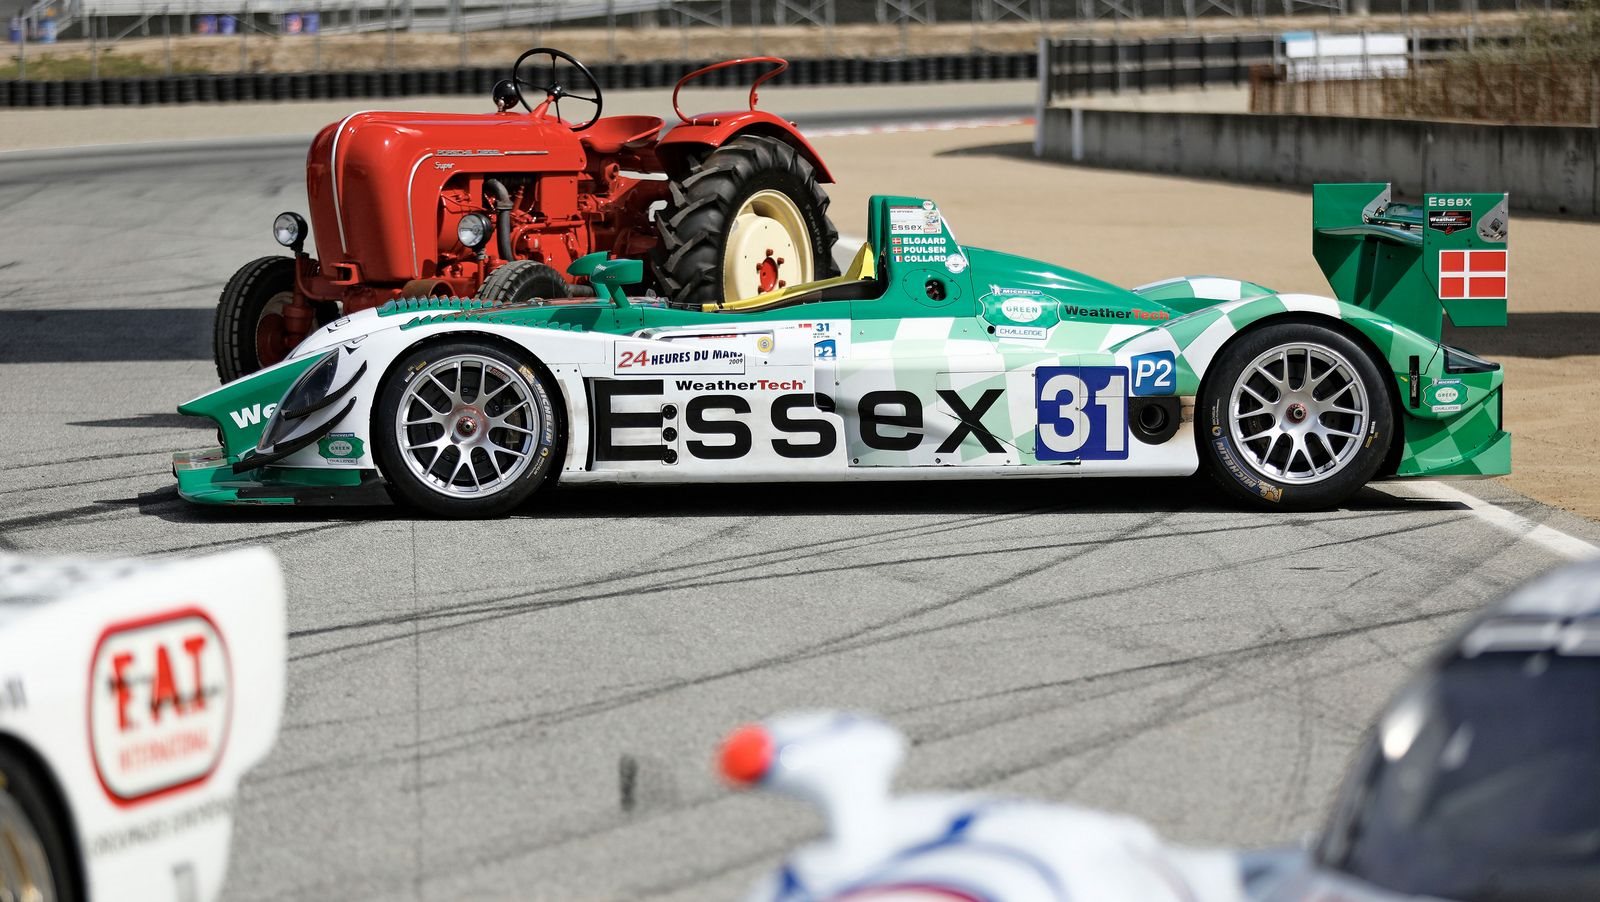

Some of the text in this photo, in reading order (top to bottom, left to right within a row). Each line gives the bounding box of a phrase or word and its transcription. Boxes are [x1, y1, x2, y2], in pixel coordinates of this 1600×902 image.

[1428, 196, 1472, 207] Essex
[891, 223, 923, 231] Essex
[903, 237, 947, 245] ELGAARD
[903, 246, 947, 254] POULSEN
[904, 255, 947, 263] COLLARD
[1006, 305, 1039, 314] GREEN
[1064, 304, 1171, 321] WeatherTech
[816, 322, 830, 332] 31
[999, 328, 1043, 337] CHALLENGE
[814, 346, 834, 358] P2
[617, 349, 650, 369] 24
[651, 351, 691, 366] HEURES
[693, 350, 709, 362] DU
[1134, 358, 1173, 388] P2
[675, 379, 804, 391] WeatherTech
[536, 383, 552, 443] MICHELIN
[1038, 374, 1126, 453] 31
[594, 379, 1008, 462] Essex
[1215, 441, 1257, 489] MICHELIN
